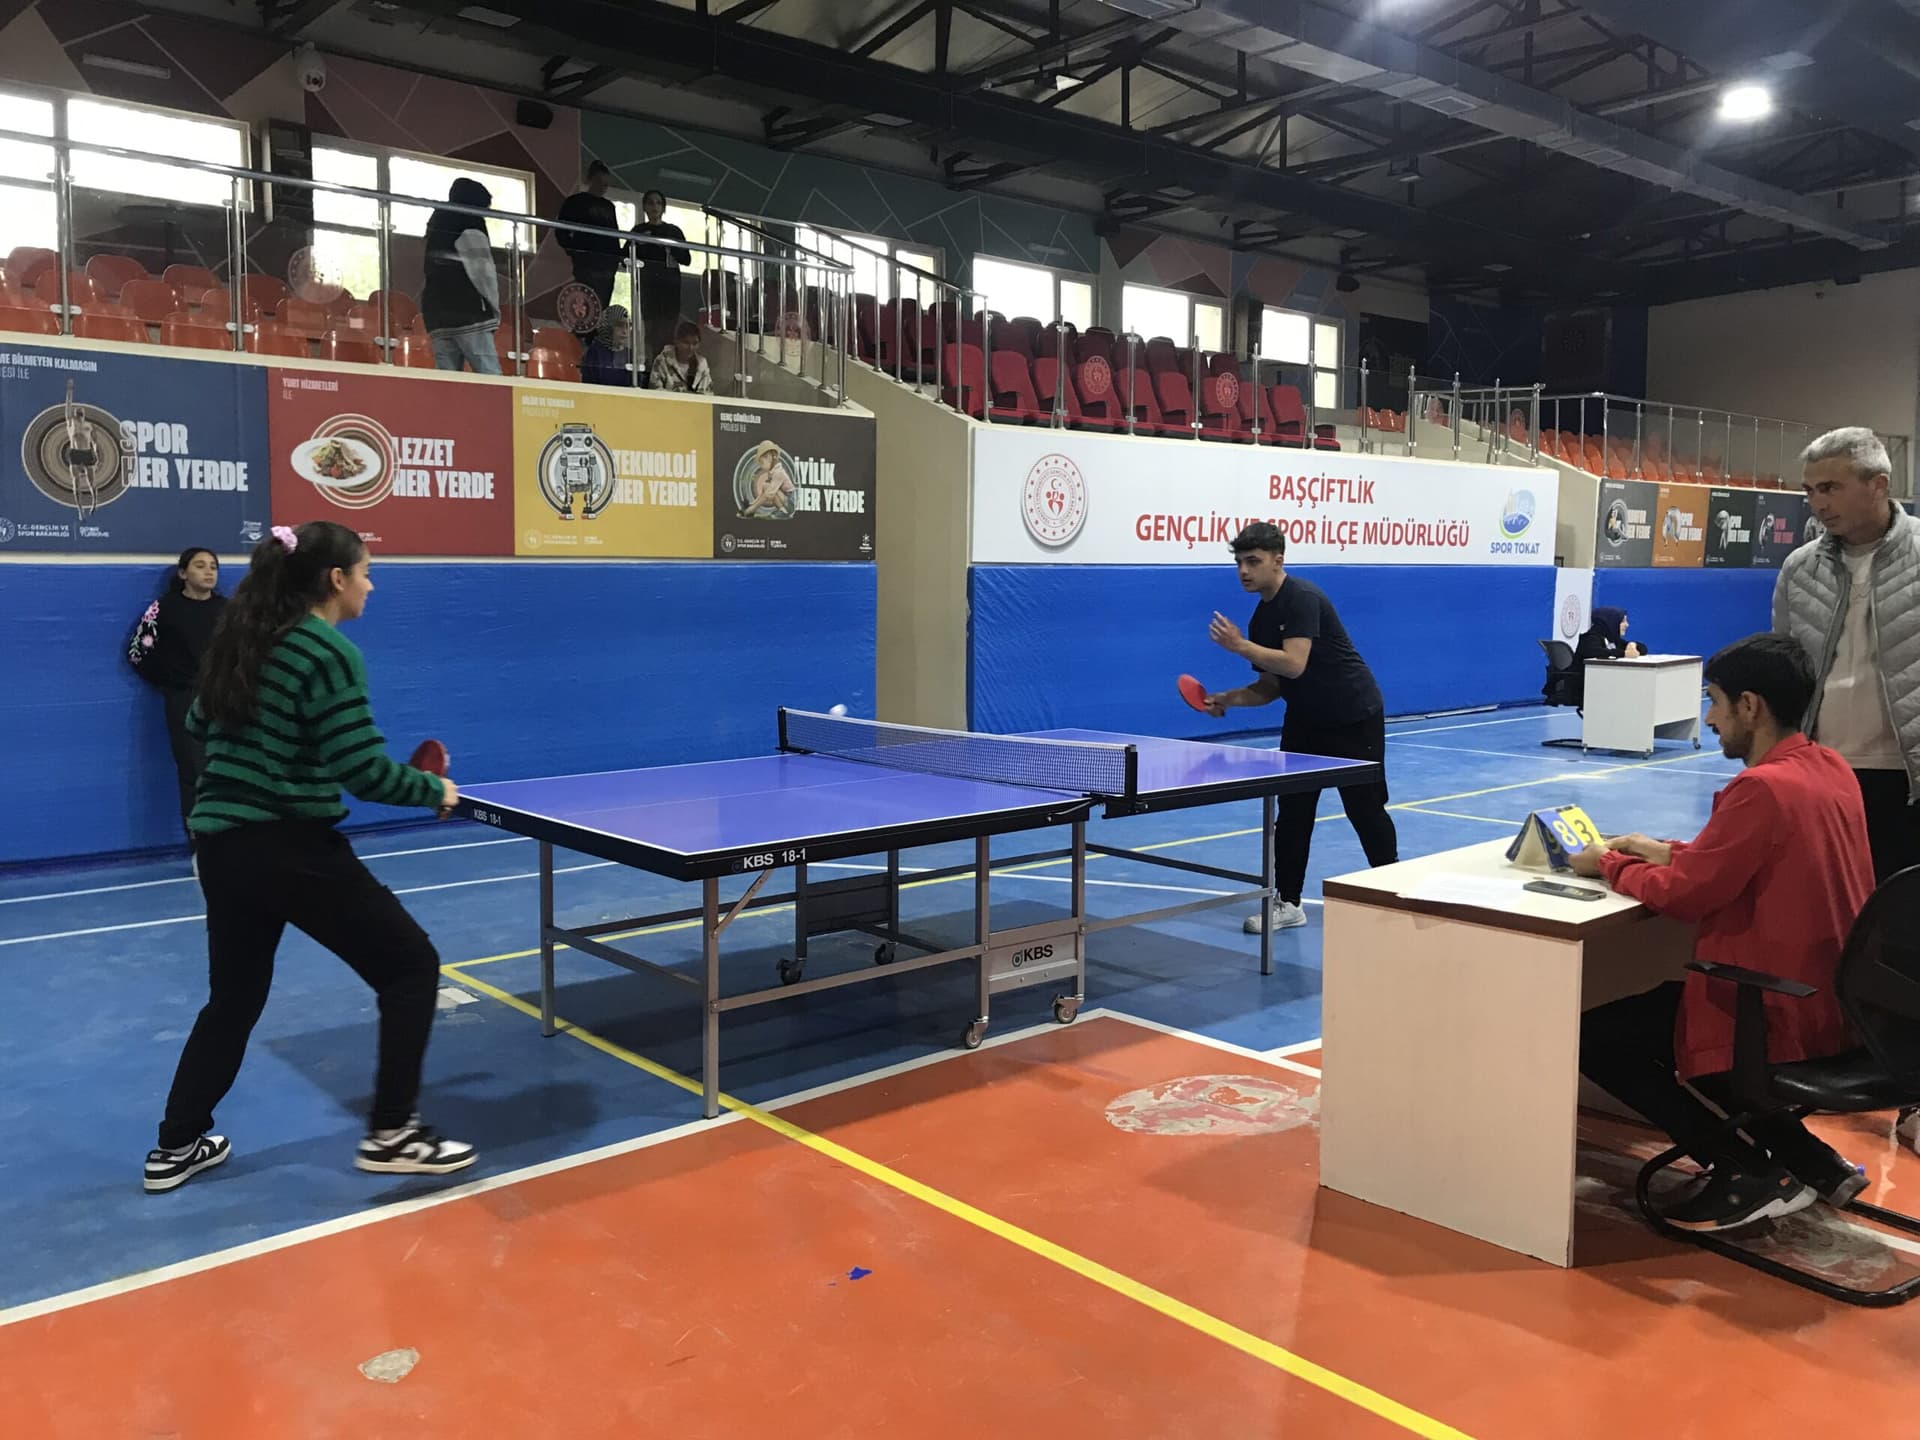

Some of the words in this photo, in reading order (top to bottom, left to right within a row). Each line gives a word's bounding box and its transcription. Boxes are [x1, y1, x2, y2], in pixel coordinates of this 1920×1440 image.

[12, 352, 53, 368] BİLMEYEN
[54, 358, 98, 372] KALMASIN
[119, 420, 189, 454] SPOR
[391, 437, 455, 467] LEZZET
[612, 449, 697, 479] TEKNOLOJİ
[120, 455, 170, 489] HER
[174, 459, 249, 492] YERDE
[391, 469, 431, 498] HER
[435, 471, 495, 499] YERDE
[794, 456, 836, 486] İYİLİK
[613, 479, 644, 504] HER
[648, 480, 697, 507] YERDE
[823, 489, 865, 513] YERDE
[1269, 472, 1375, 508] BAŞÇİFTLİK
[1136, 511, 1230, 550] GENÇLİK
[1321, 515, 1358, 550] İLÇE
[1363, 517, 1470, 547] MÜDÜRLÜĞÜ
[1490, 542, 1512, 555] SPOR
[1514, 542, 1540, 555] TOKAT
[474, 809, 488, 823] KBS
[489, 813, 502, 826] 18-1
[1552, 820, 1578, 847] 8
[1574, 819, 1594, 845] 3
[743, 853, 774, 870] KBS
[782, 848, 807, 864] 18-1
[1023, 944, 1054, 962] KBS
